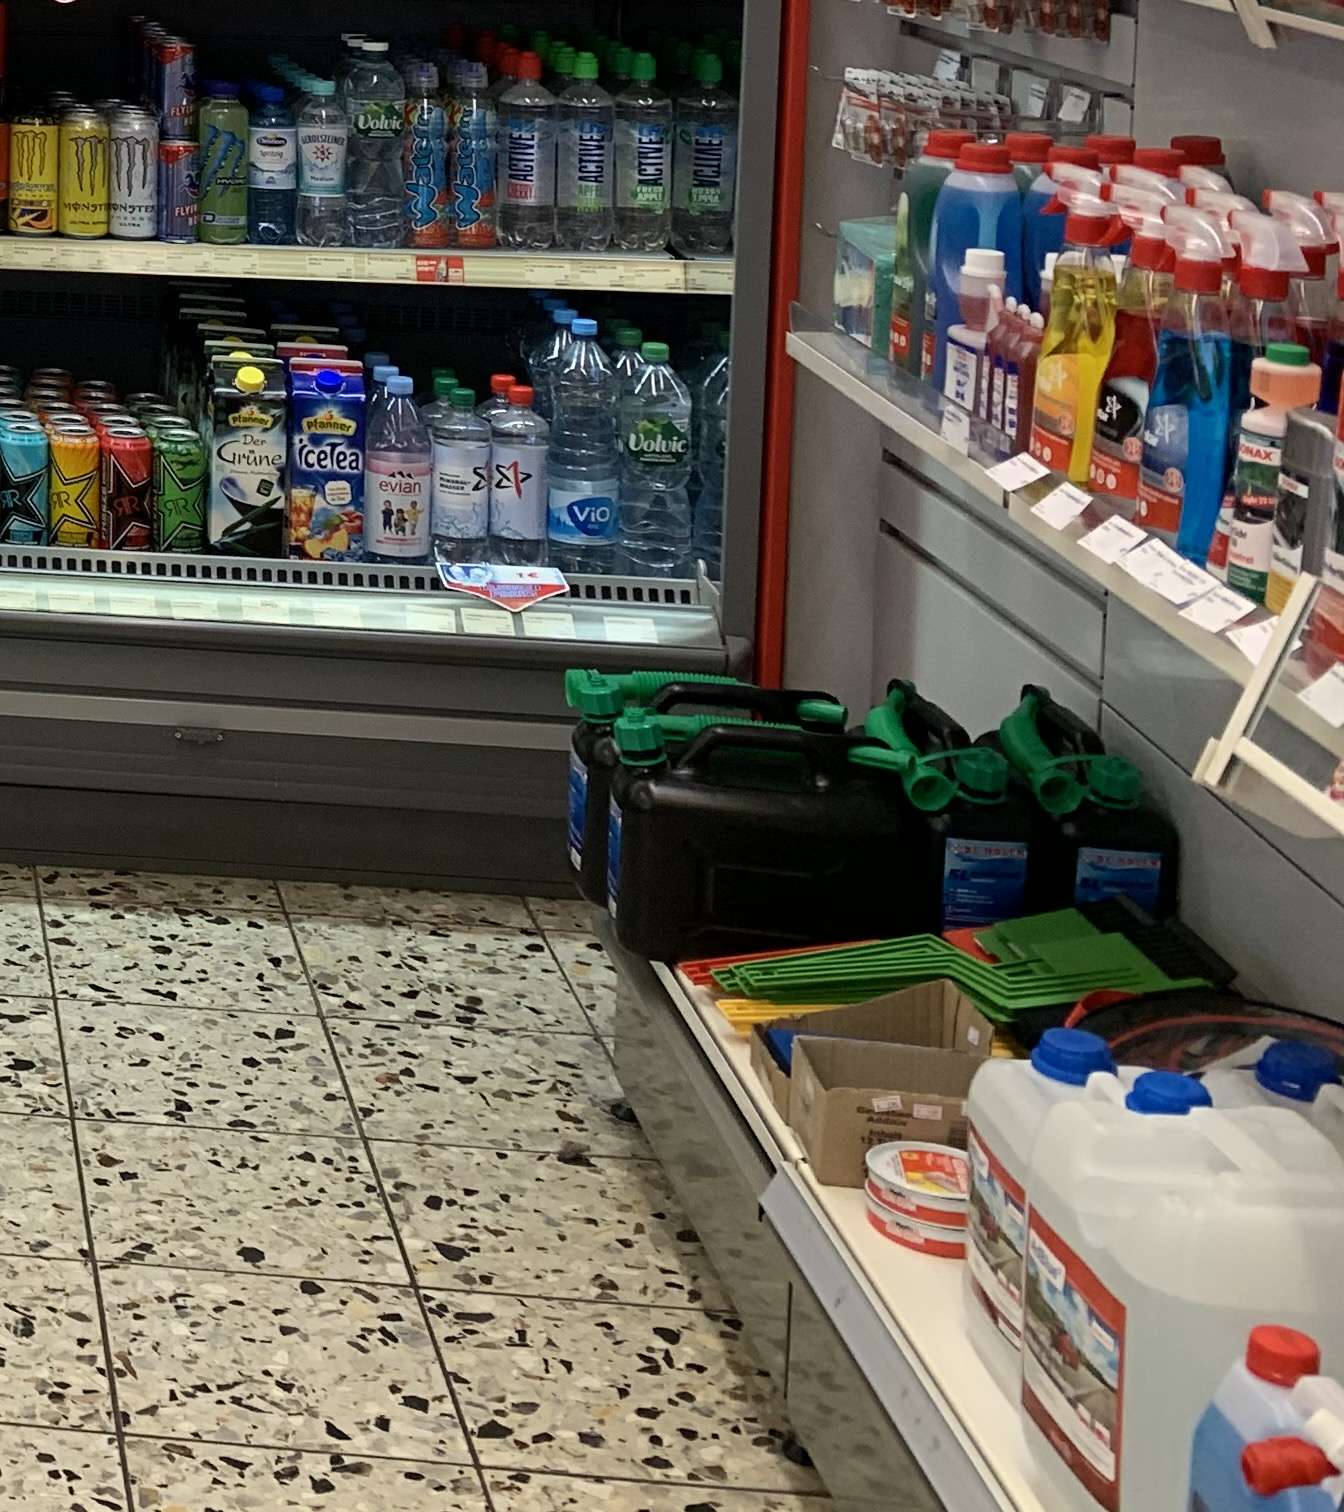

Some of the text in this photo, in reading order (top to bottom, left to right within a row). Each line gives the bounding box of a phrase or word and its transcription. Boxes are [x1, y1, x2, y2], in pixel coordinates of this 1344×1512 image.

[358, 113, 404, 133] Volvic
[509, 132, 534, 183] ACTIVE
[578, 132, 605, 184] ACTIVE
[638, 137, 663, 185] ACTIVE
[305, 416, 355, 437] pfanner
[242, 433, 267, 447] Der
[627, 432, 688, 454] Volvic
[217, 438, 283, 468] Grüne
[379, 477, 422, 494] evian
